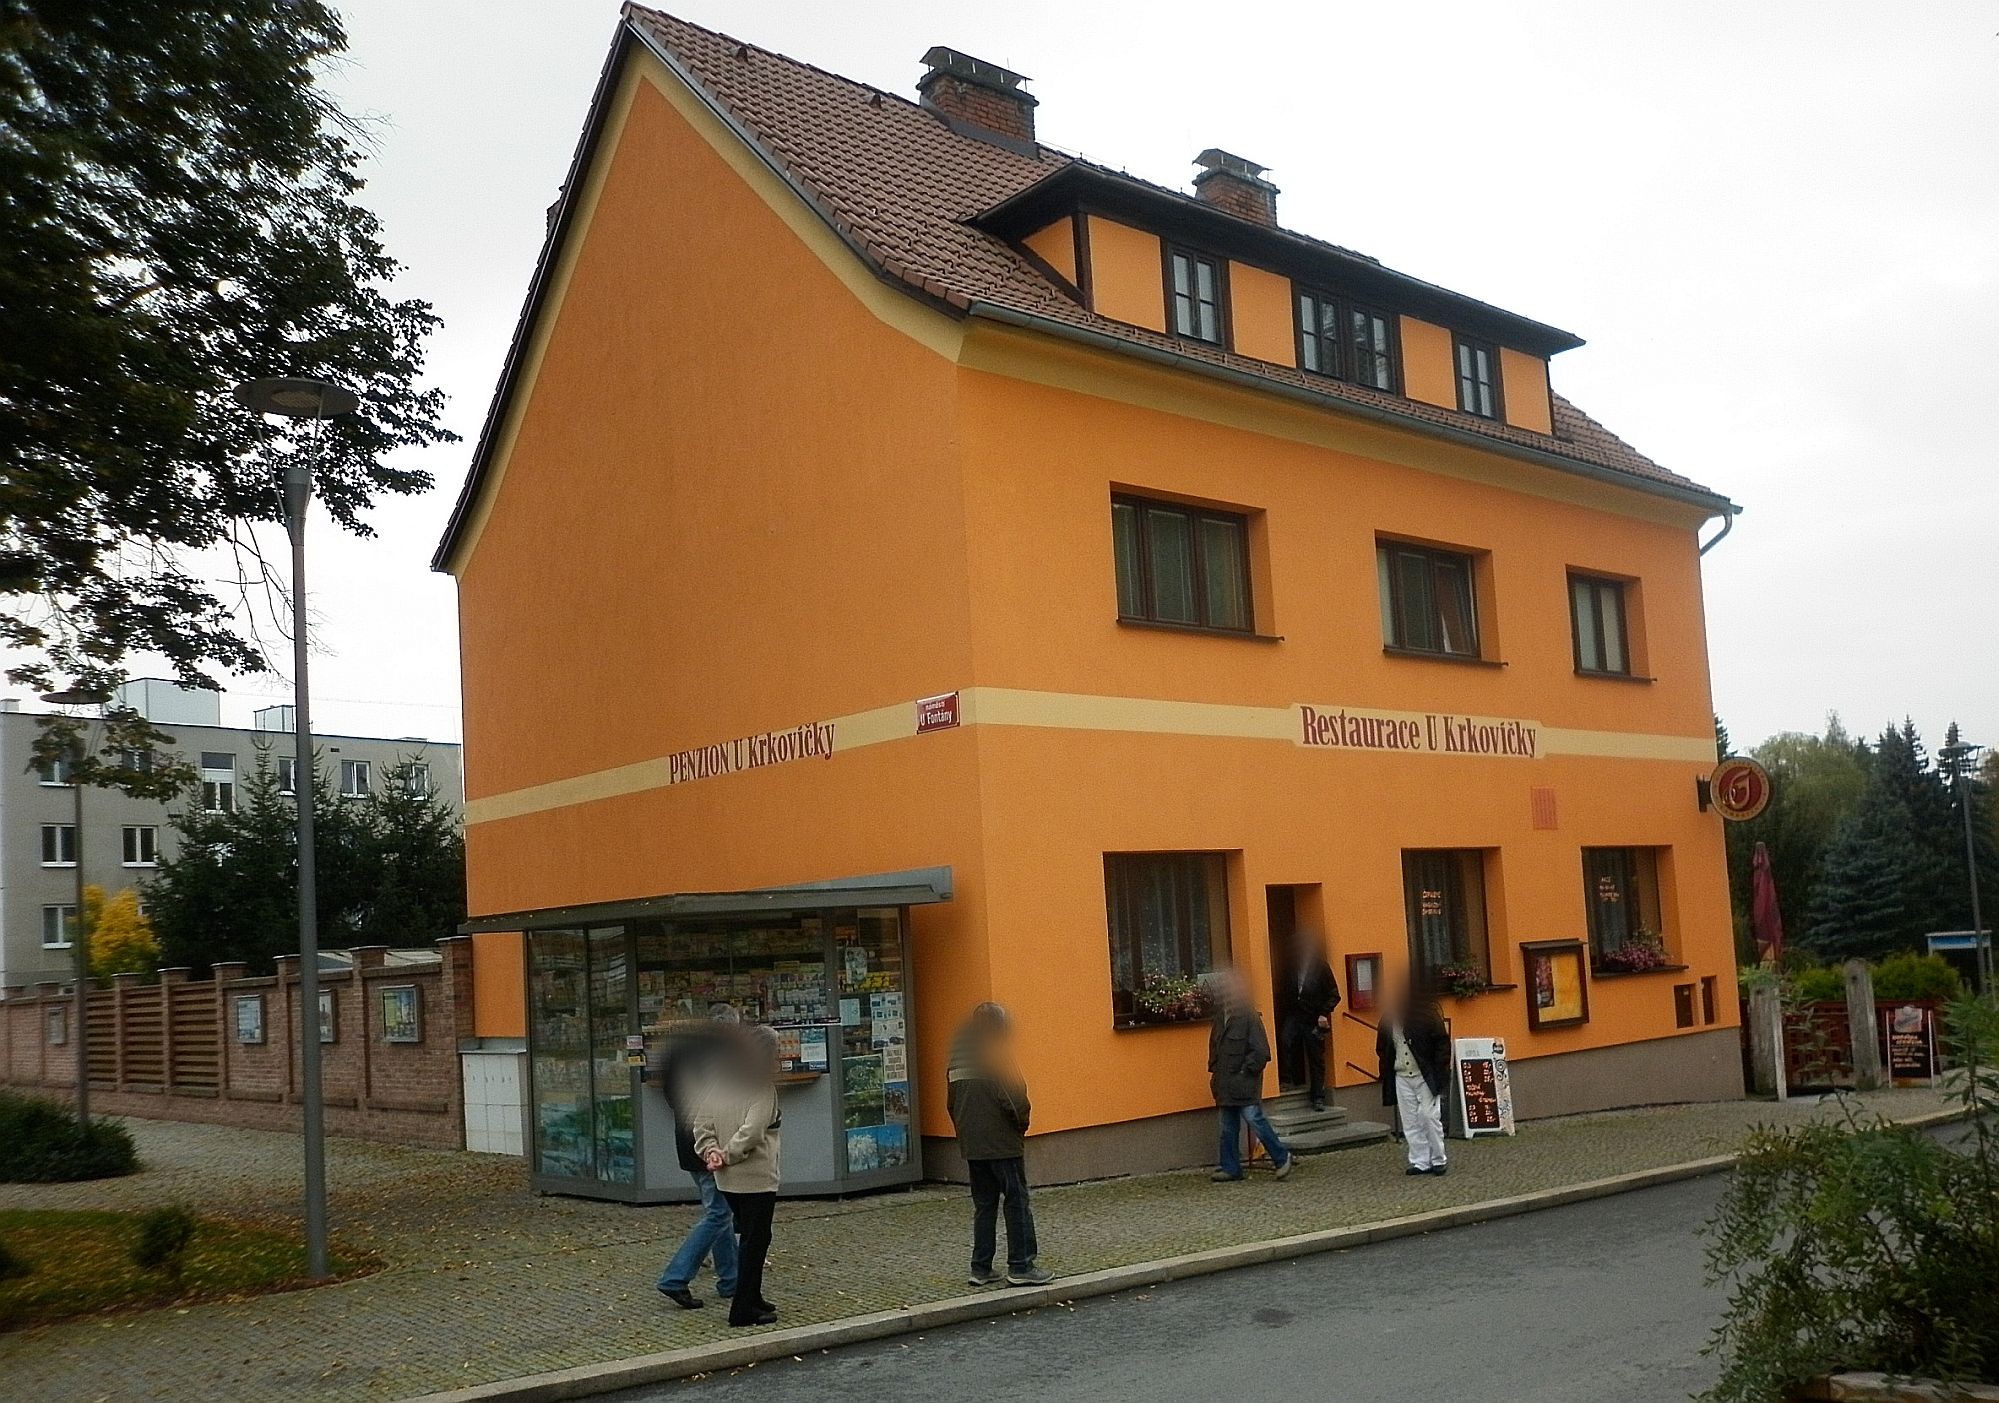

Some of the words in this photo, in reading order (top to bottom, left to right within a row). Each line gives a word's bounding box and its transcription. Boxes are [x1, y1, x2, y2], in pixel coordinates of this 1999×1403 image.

[920, 713, 926, 727] U
[927, 709, 952, 725] Fontány
[1300, 705, 1421, 750] Restaurace
[1425, 715, 1438, 751] U
[1443, 716, 1536, 758] Krkovíčky
[669, 742, 730, 784] PENZION
[733, 739, 743, 771] U
[748, 721, 835, 768] Krkovíčky
